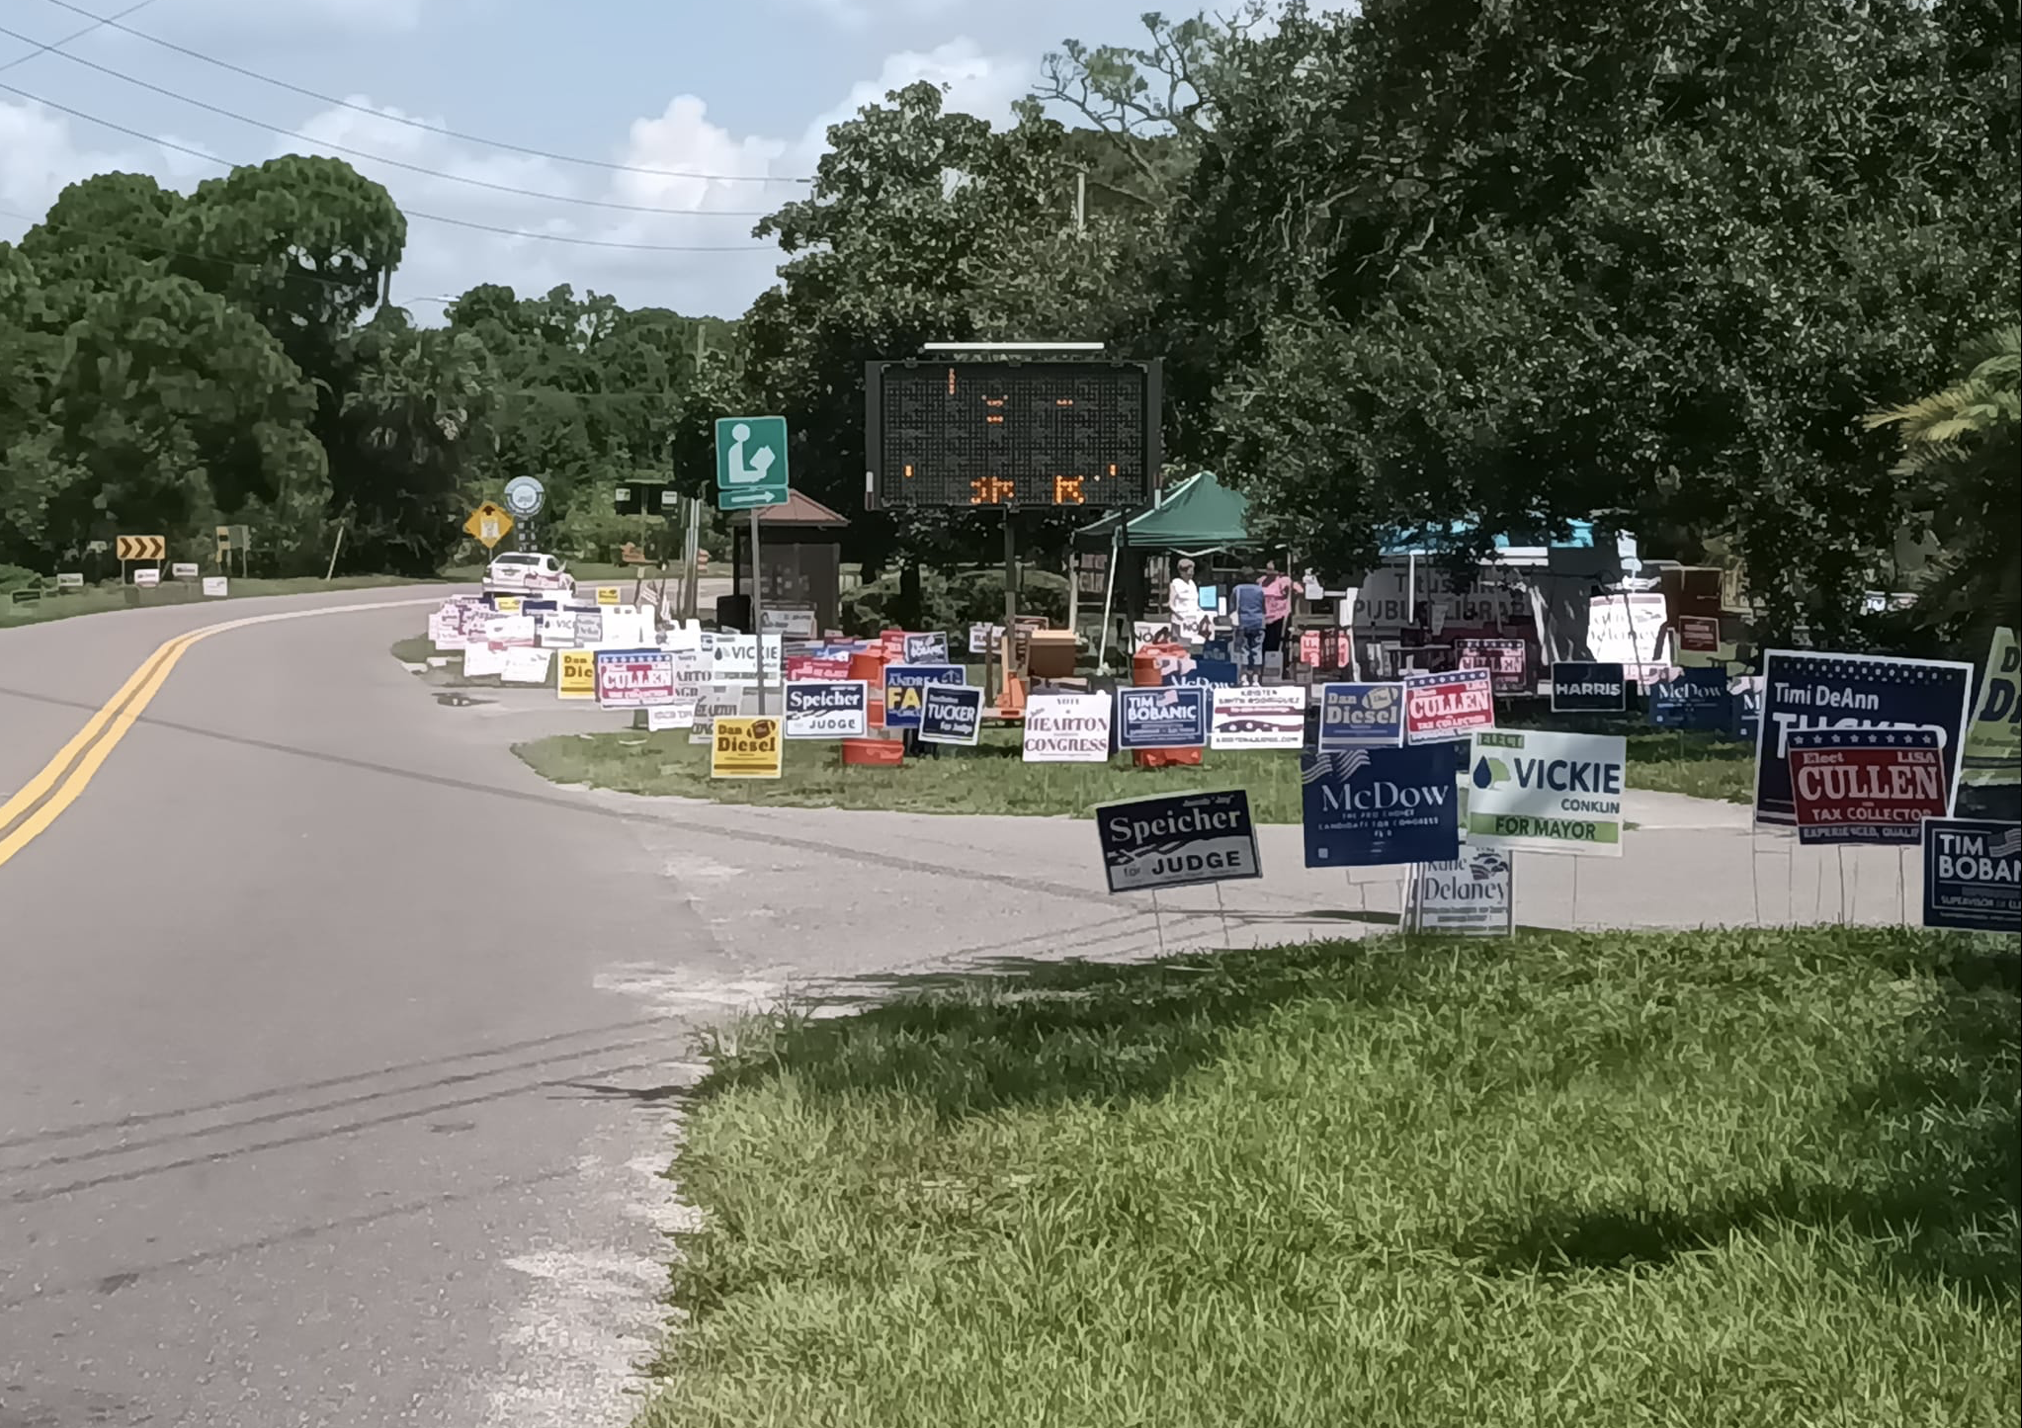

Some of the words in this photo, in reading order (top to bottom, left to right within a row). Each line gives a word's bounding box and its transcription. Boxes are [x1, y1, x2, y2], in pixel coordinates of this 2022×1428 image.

[732, 646, 778, 660] VICIE
[1327, 693, 1357, 704] Dan
[1556, 683, 1622, 696] HARRIS
[1774, 682, 1811, 706] Timi
[1815, 685, 1880, 711] DeAnn
[790, 690, 861, 710] Speicher
[1128, 697, 1154, 707] TIM
[1409, 690, 1489, 719] CULLEN
[928, 703, 975, 721] TUCKER
[1127, 706, 1197, 721] BOBANIC
[1326, 706, 1397, 724] Diesel
[718, 724, 742, 735] Dan
[809, 719, 856, 729] JUDGE
[1027, 718, 1108, 732] HEARTON
[717, 736, 775, 752] Diesel
[1025, 738, 1107, 752] CONGRESS
[1803, 751, 1845, 765] Elect
[1897, 751, 1936, 764] LISA
[1514, 758, 1621, 795] VICKIE
[1800, 765, 1938, 801] CULLEN
[1321, 781, 1449, 812] McDow
[1812, 809, 1842, 821] TAX
[1109, 806, 1241, 845] Speicher
[1495, 816, 1530, 834] FOR
[1534, 820, 1597, 840] MAYOR
[1939, 834, 1984, 856] TIM
[1123, 865, 1141, 878] for
[1152, 850, 1241, 875] JUDGE
[1424, 876, 1504, 905] Delaney
